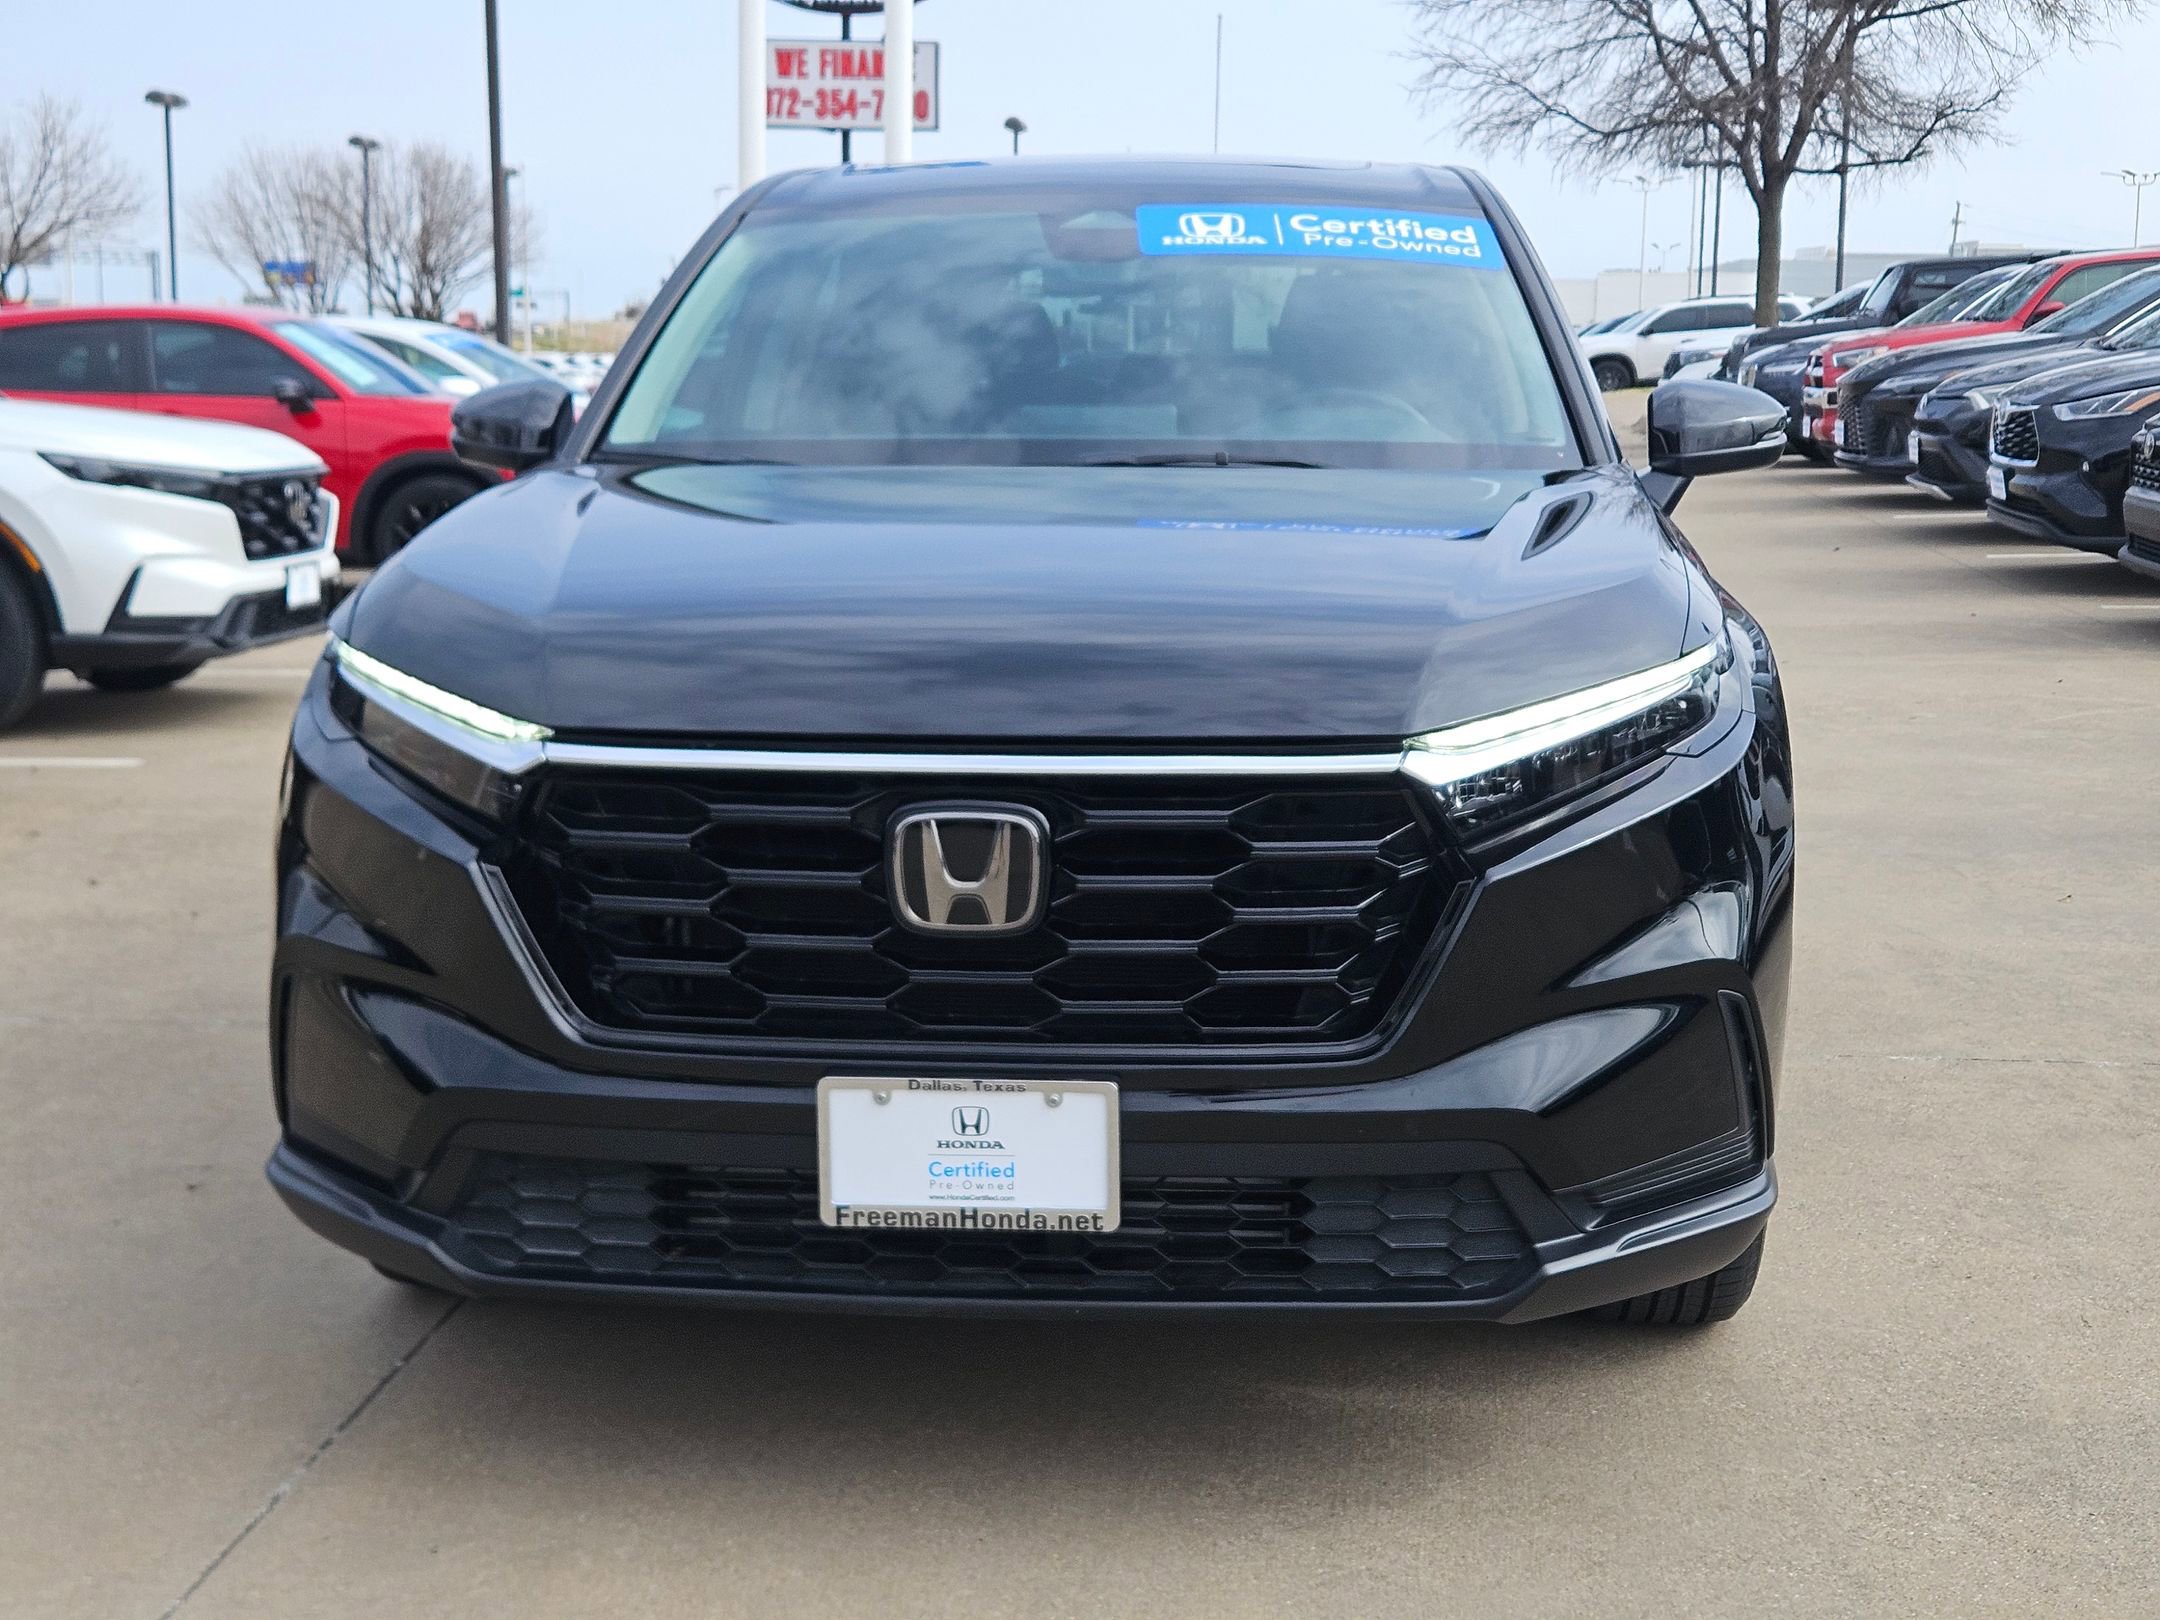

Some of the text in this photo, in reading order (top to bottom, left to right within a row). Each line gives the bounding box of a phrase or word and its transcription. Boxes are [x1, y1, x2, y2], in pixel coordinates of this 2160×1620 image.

[775, 48, 917, 80] WE FINAN
[767, 87, 928, 121] 72-354-70
[1290, 214, 1479, 244] Certified
[1161, 235, 1268, 246] HONDA
[1304, 232, 1482, 258] Pre-Owned
[908, 1079, 1026, 1092] Dallas, Texas
[936, 1140, 1005, 1149] HONDA
[928, 1161, 1015, 1178] Certified
[929, 1180, 1014, 1190] Pre-Owned
[835, 1206, 1104, 1231] FreemanHonda.net
